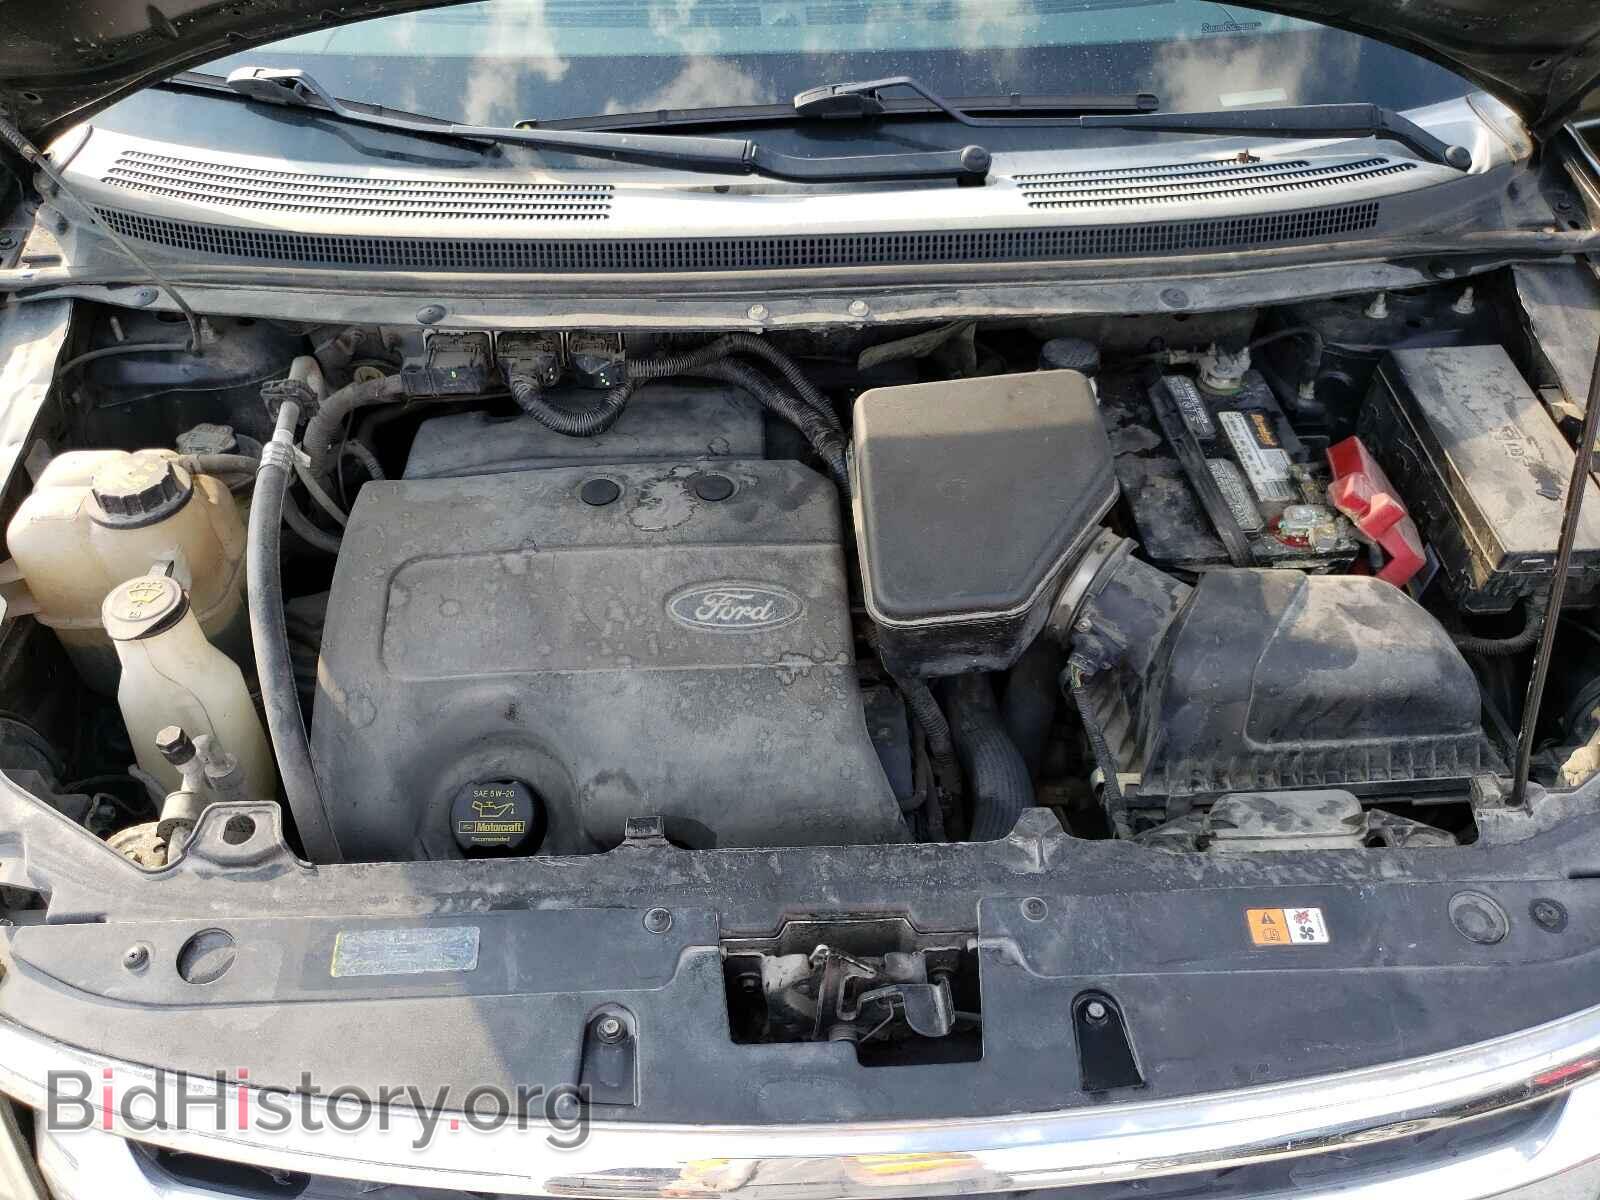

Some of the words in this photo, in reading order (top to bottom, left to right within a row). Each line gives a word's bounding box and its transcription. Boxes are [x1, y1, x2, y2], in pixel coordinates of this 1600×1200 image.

[695, 592, 775, 620] Ford
[473, 790, 489, 798] SAE
[476, 822, 522, 832] Motorcraft
